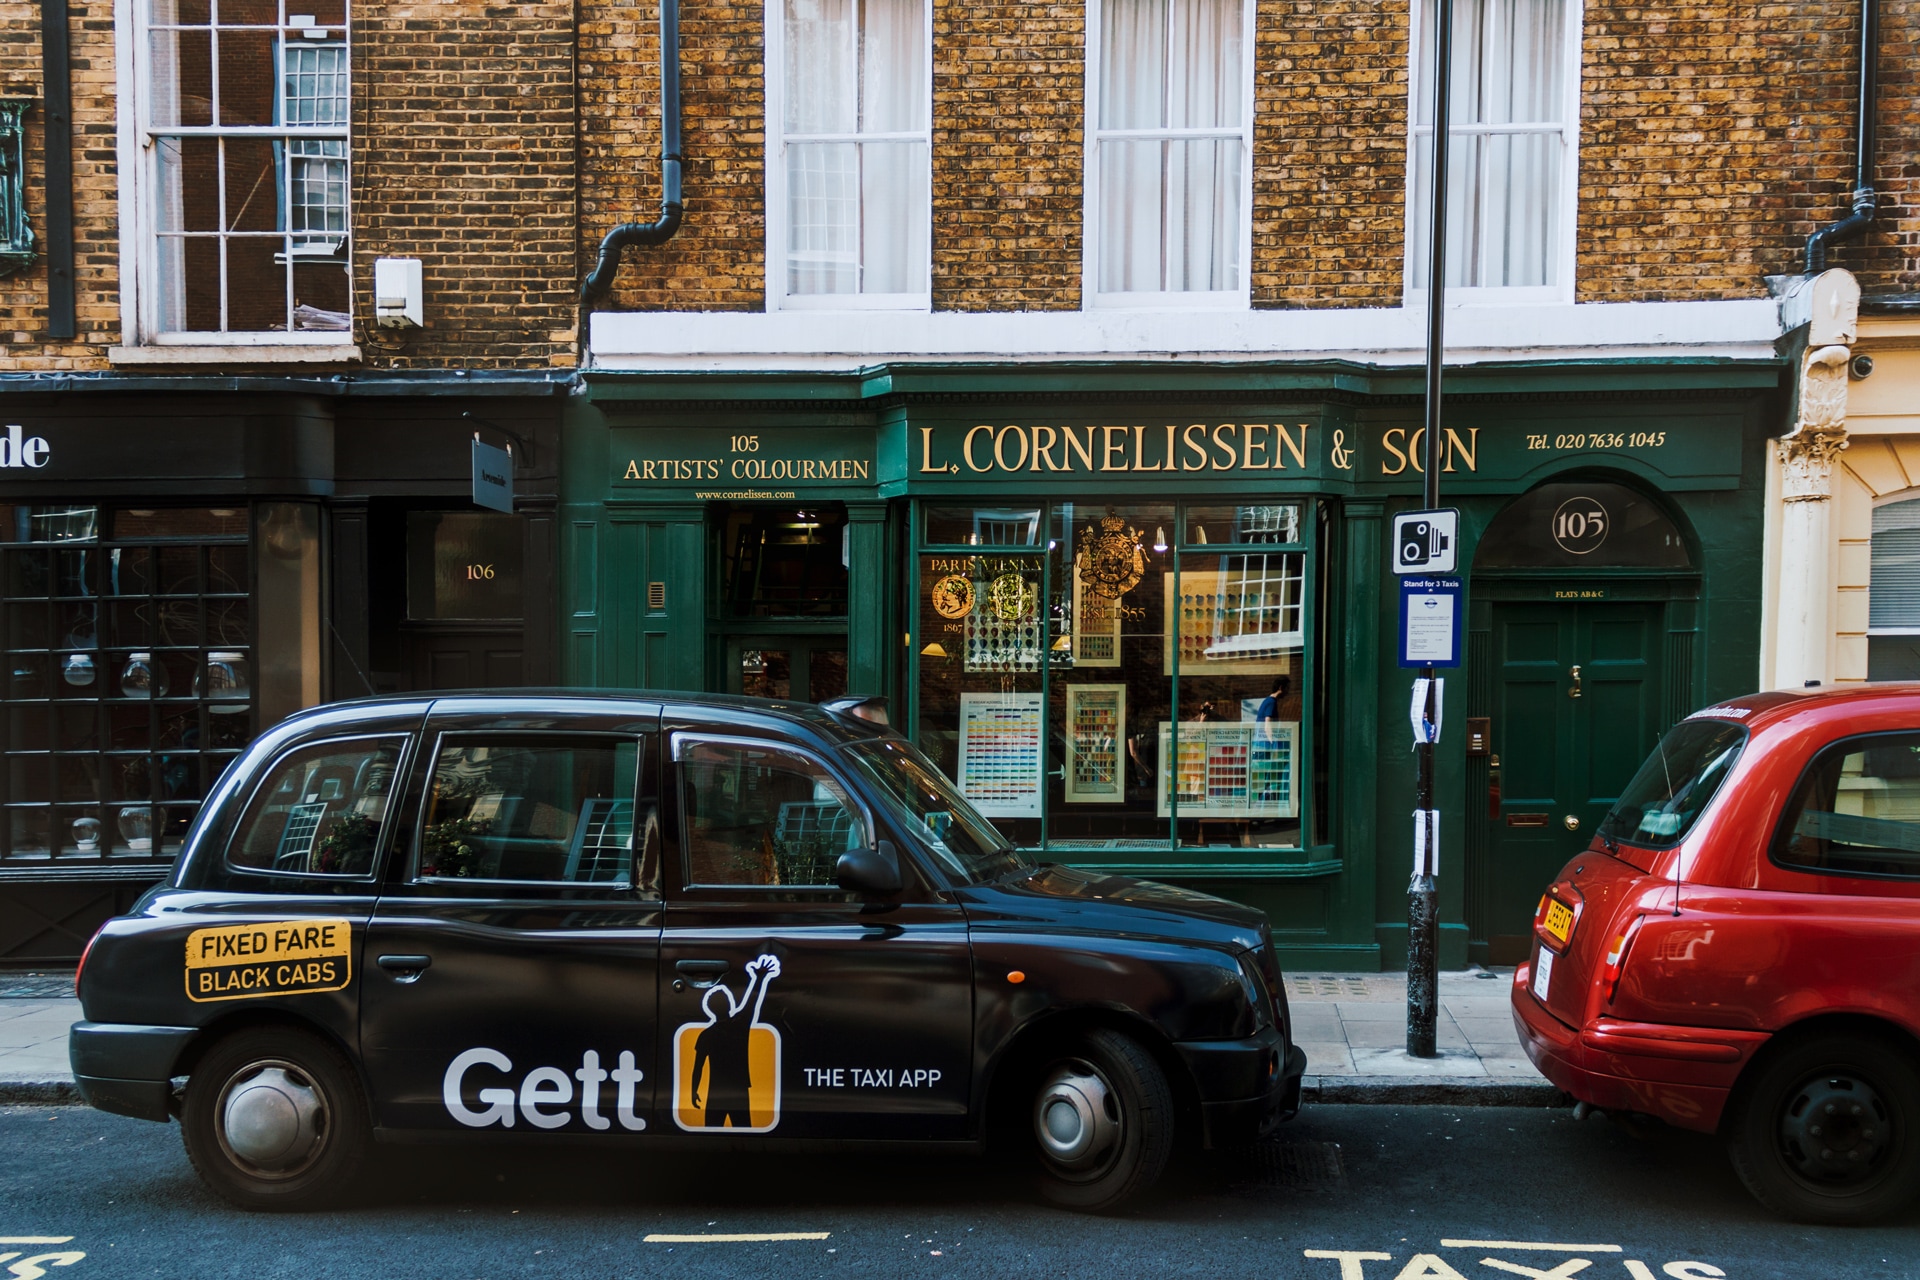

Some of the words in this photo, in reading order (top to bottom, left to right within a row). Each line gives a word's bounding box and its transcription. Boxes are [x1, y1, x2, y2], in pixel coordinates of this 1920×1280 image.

[730, 435, 760, 452] 105
[1331, 429, 1355, 470] &
[1526, 434, 1551, 450] Tel.
[1555, 433, 1586, 449] 020
[1588, 432, 1624, 448] 7636
[1628, 431, 1667, 447] 1045
[623, 458, 725, 480] ARTISTS'
[731, 459, 870, 480] COLOURMEN
[695, 488, 796, 500] www.cornelissen.com
[1557, 511, 1604, 538] 105
[466, 563, 495, 580] 106
[931, 559, 976, 571] PARIS
[1403, 580, 1424, 588] Stand
[1425, 580, 1435, 588] for
[1435, 580, 1441, 588] 3
[1442, 580, 1459, 588] Taxis
[1555, 590, 1579, 599] FLATS
[943, 623, 963, 634] 1867
[201, 931, 268, 959] FIXED
[274, 925, 336, 952] FARE
[199, 966, 271, 993] BLACK
[276, 961, 336, 986] CABS
[803, 1068, 845, 1087] THE
[850, 1068, 893, 1088] TAXI
[898, 1069, 942, 1088] APP
[442, 1047, 648, 1132] Gett
